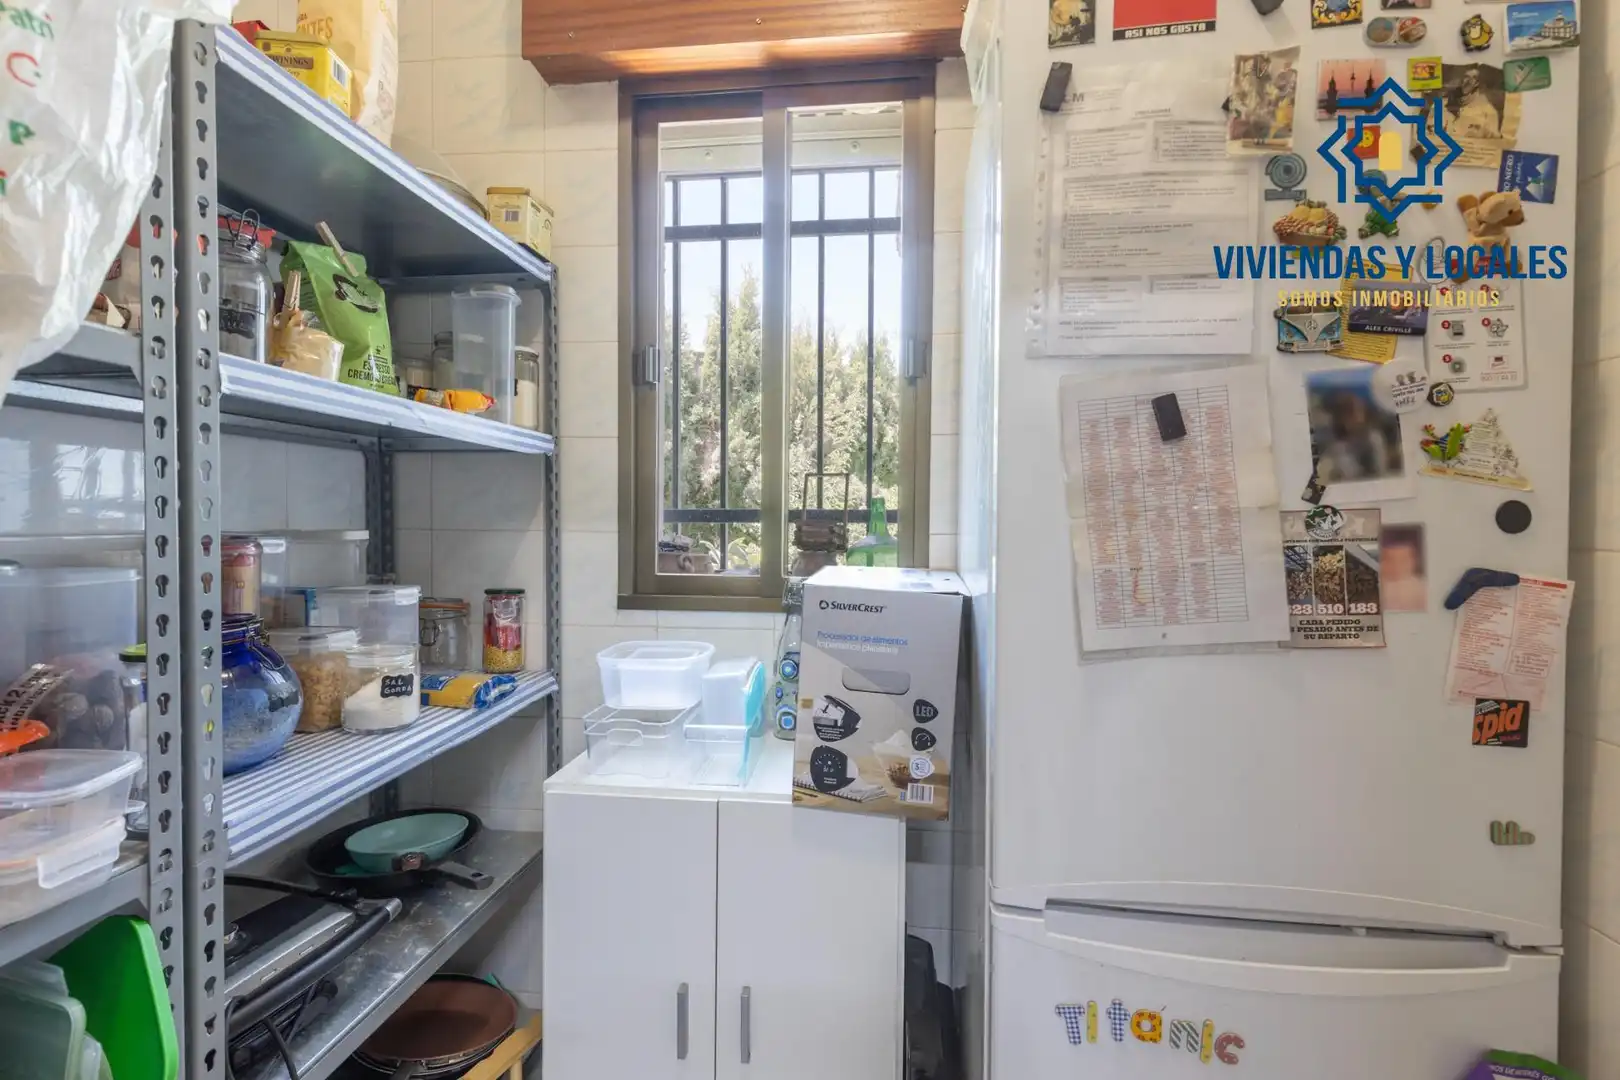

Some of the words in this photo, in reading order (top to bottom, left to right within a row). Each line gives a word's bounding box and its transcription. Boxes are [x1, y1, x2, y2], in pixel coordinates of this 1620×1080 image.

[1125, 29, 1143, 39] ASI
[1145, 26, 1168, 36] NOS
[1170, 23, 1206, 34] GUSTA
[270, 55, 309, 65] WININGS
[1290, 604, 1313, 614] 23
[1317, 604, 1344, 614] 510
[1349, 603, 1378, 613] 183
[384, 678, 404, 686] SAL
[915, 705, 934, 718] LED
